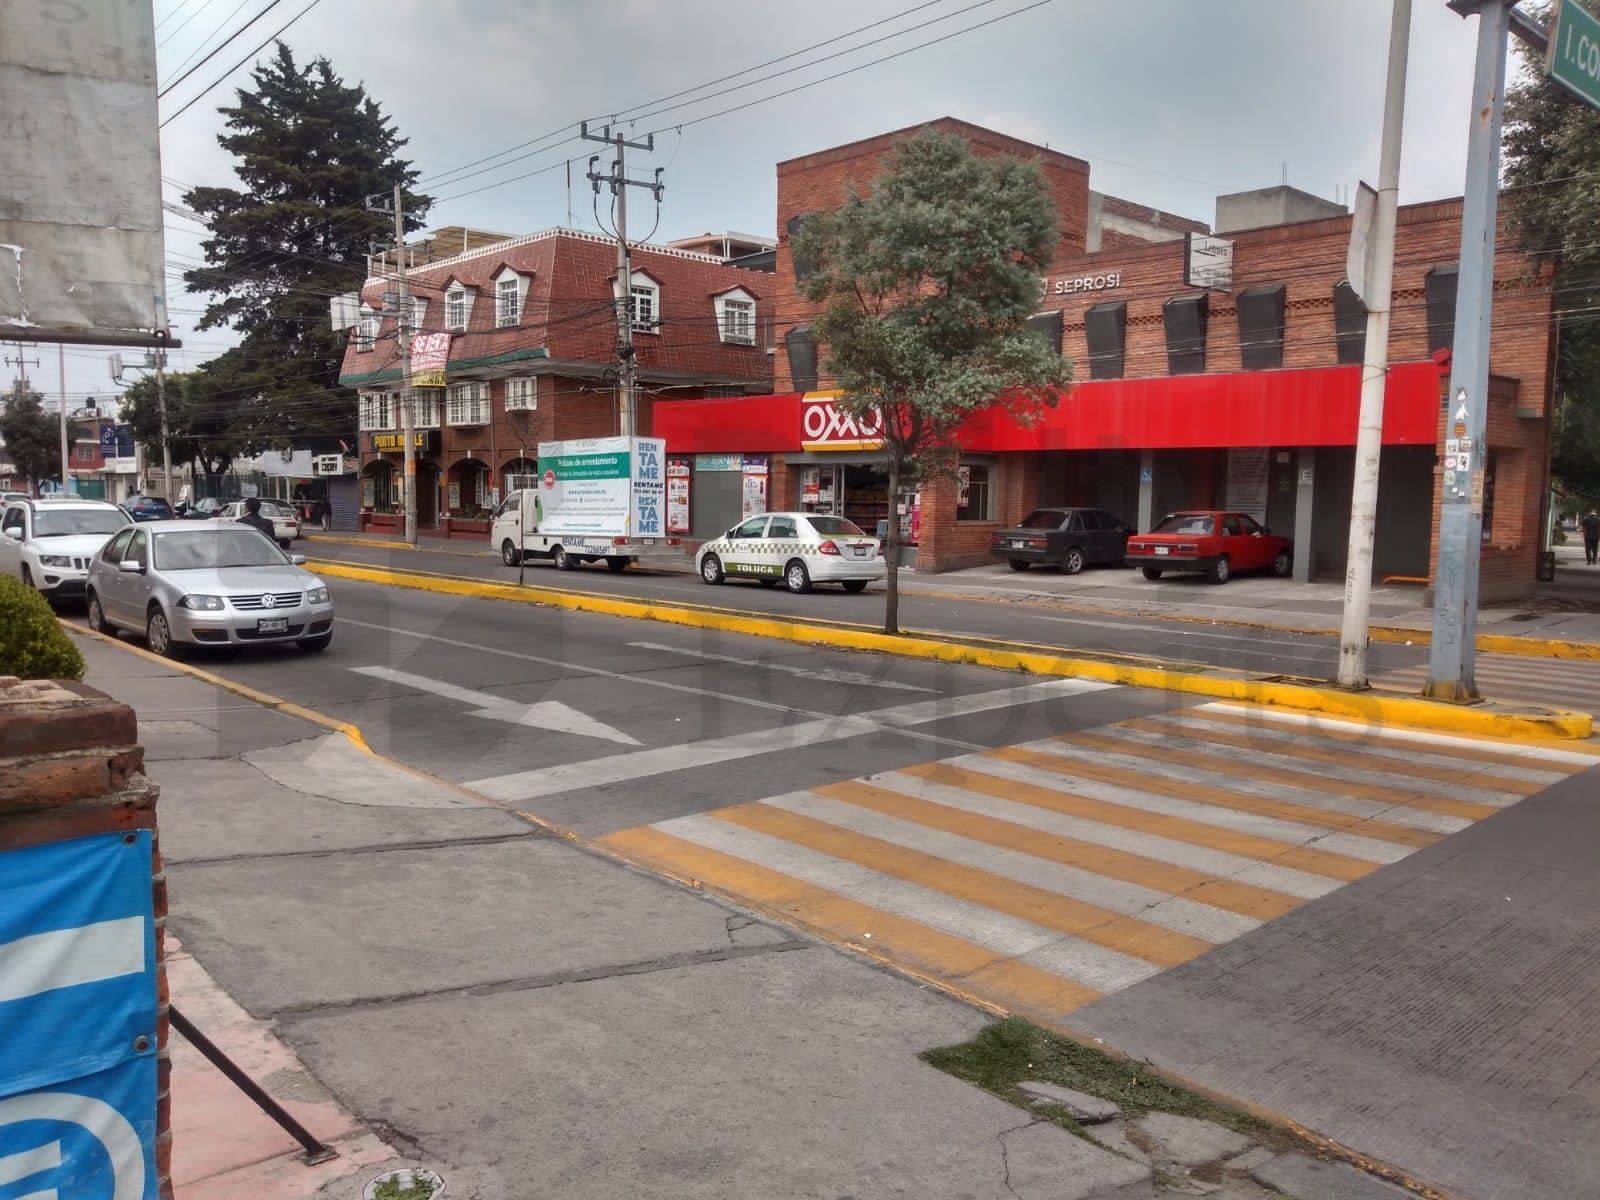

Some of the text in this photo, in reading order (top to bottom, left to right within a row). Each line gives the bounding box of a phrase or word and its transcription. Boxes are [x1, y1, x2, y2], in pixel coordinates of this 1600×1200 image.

[1055, 274, 1121, 294] SEPROSI
[804, 402, 882, 441] OXXO
[638, 443, 657, 452] REN
[638, 453, 658, 466] TA
[639, 467, 658, 479] ME
[638, 496, 657, 505] REN
[638, 507, 658, 520] TA
[639, 520, 659, 533] ME
[736, 563, 774, 574] TOLUCA
